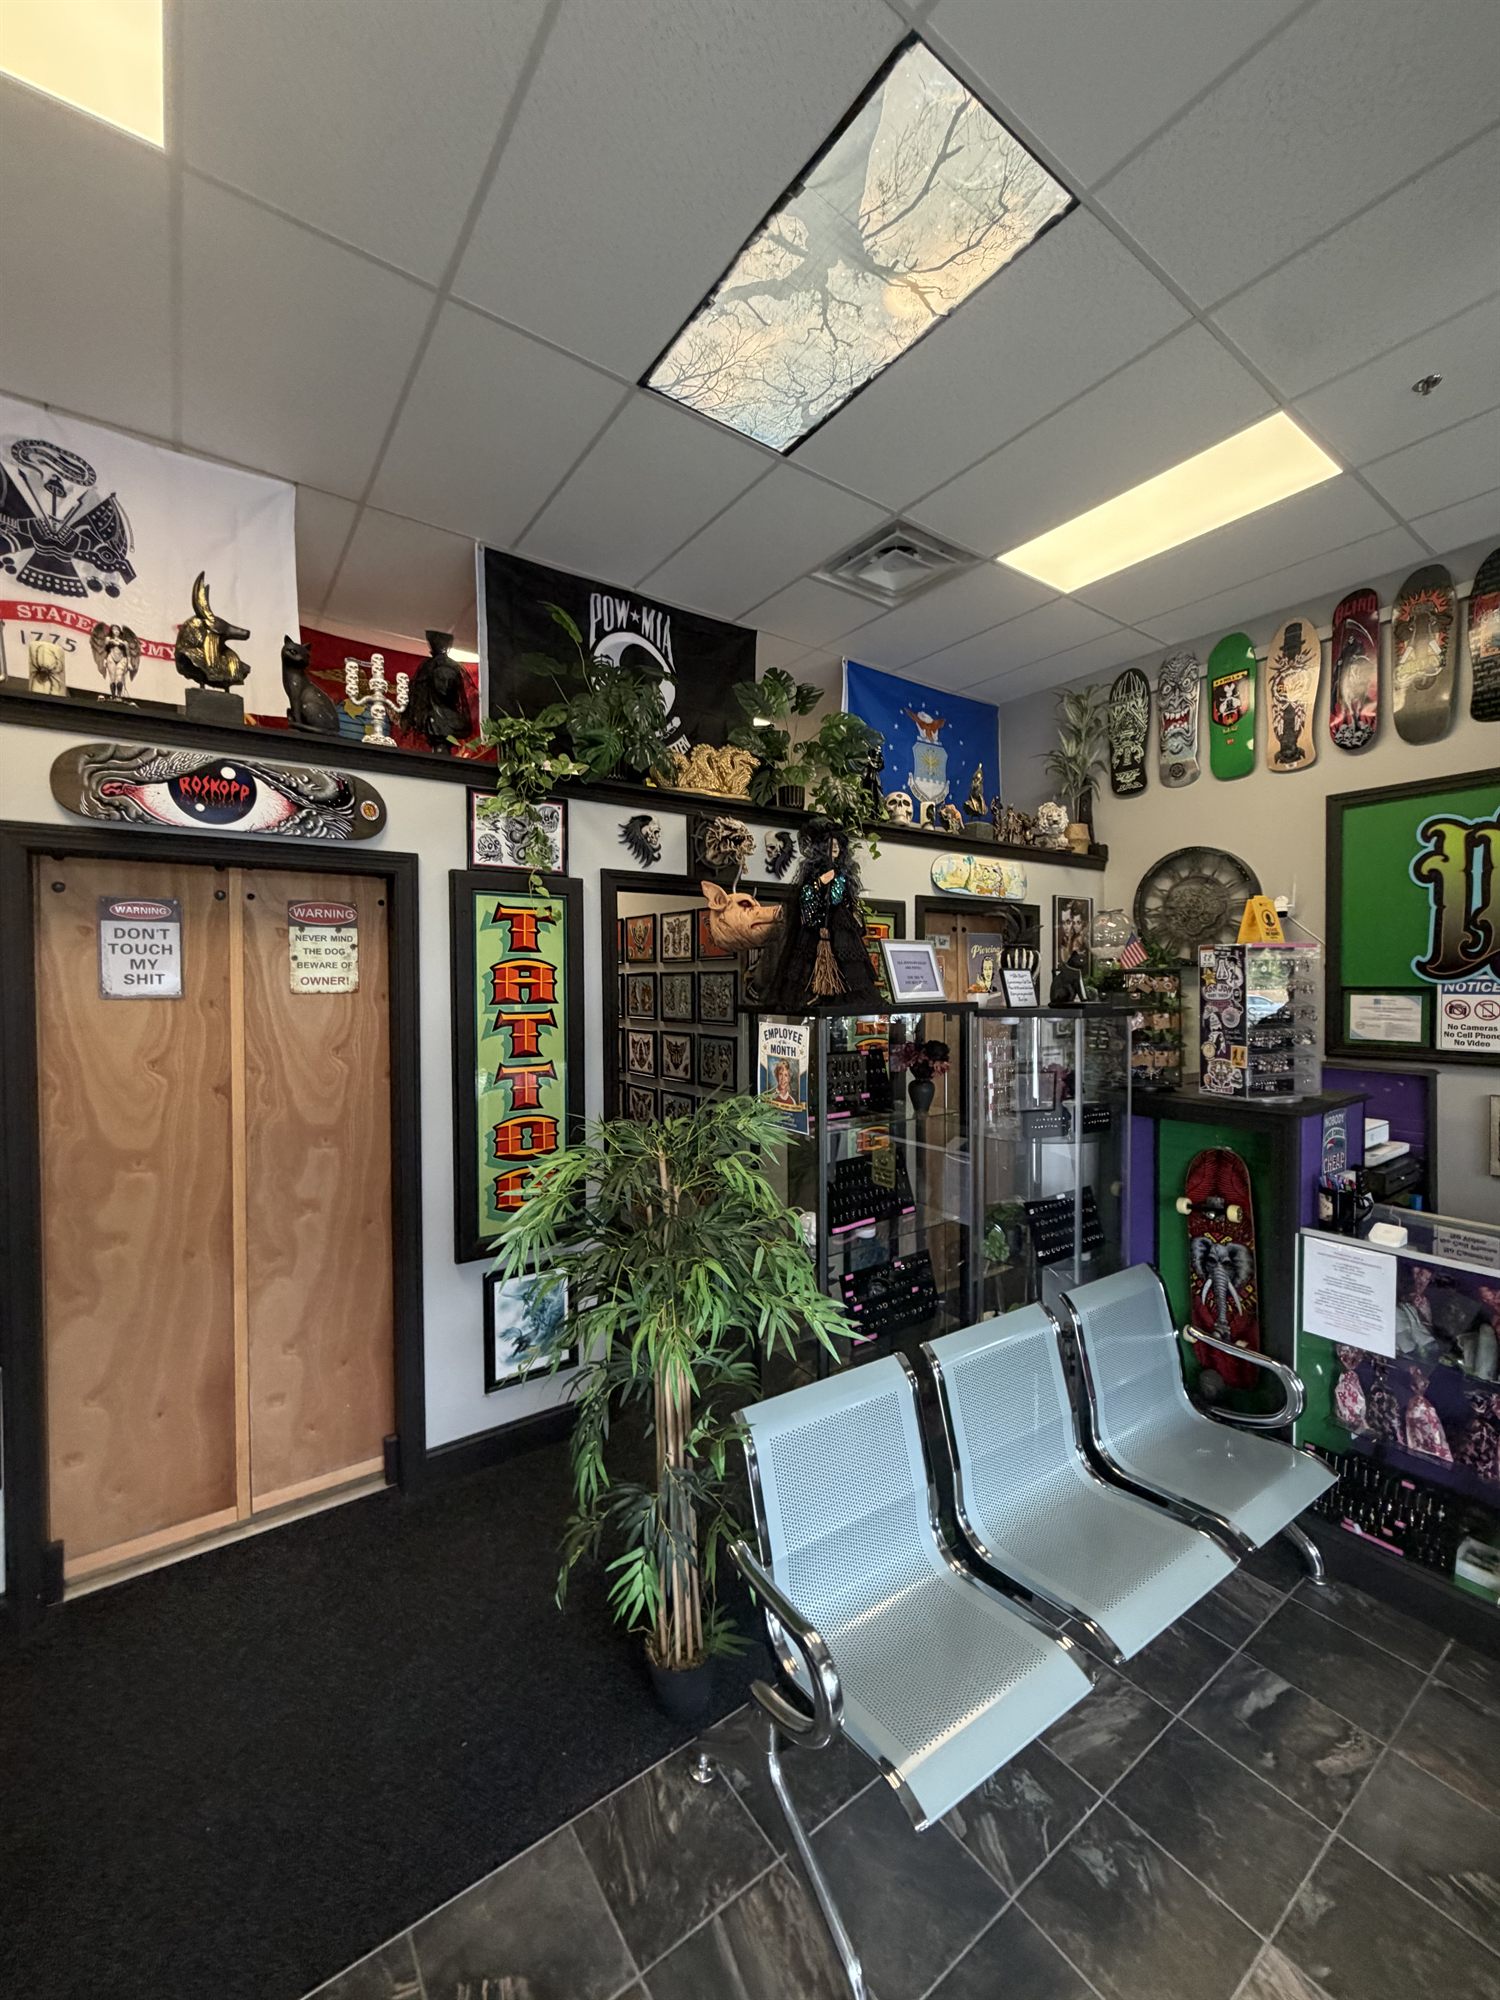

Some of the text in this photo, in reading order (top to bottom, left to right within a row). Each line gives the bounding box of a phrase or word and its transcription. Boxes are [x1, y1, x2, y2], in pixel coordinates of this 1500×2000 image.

[16, 604, 96, 633] STATE
[589, 592, 676, 672] POW MIA
[20, 630, 78, 653] 1775
[138, 638, 176, 660] RMY
[178, 774, 250, 802] ROSKOPP
[114, 906, 167, 915] WARNING
[293, 908, 354, 919] WARNING
[113, 927, 170, 940] DON'T
[295, 934, 353, 943] NEVER MIND
[107, 943, 173, 955] TOUCH
[303, 947, 346, 956] THE DOG
[129, 958, 158, 970] MY
[296, 961, 353, 969] BEWARE OF
[123, 973, 166, 985] SHIT
[300, 976, 350, 986] OWNER!
[1443, 981, 1500, 993] NOTICE
[1447, 1023, 1498, 1032] No Cameras
[763, 1027, 803, 1045] EMPLOYEE
[1456, 1031, 1473, 1039] Cell
[1467, 1039, 1490, 1048] Video
[770, 1044, 797, 1057] MONTH
[490, 901, 560, 1214] TATTOO
